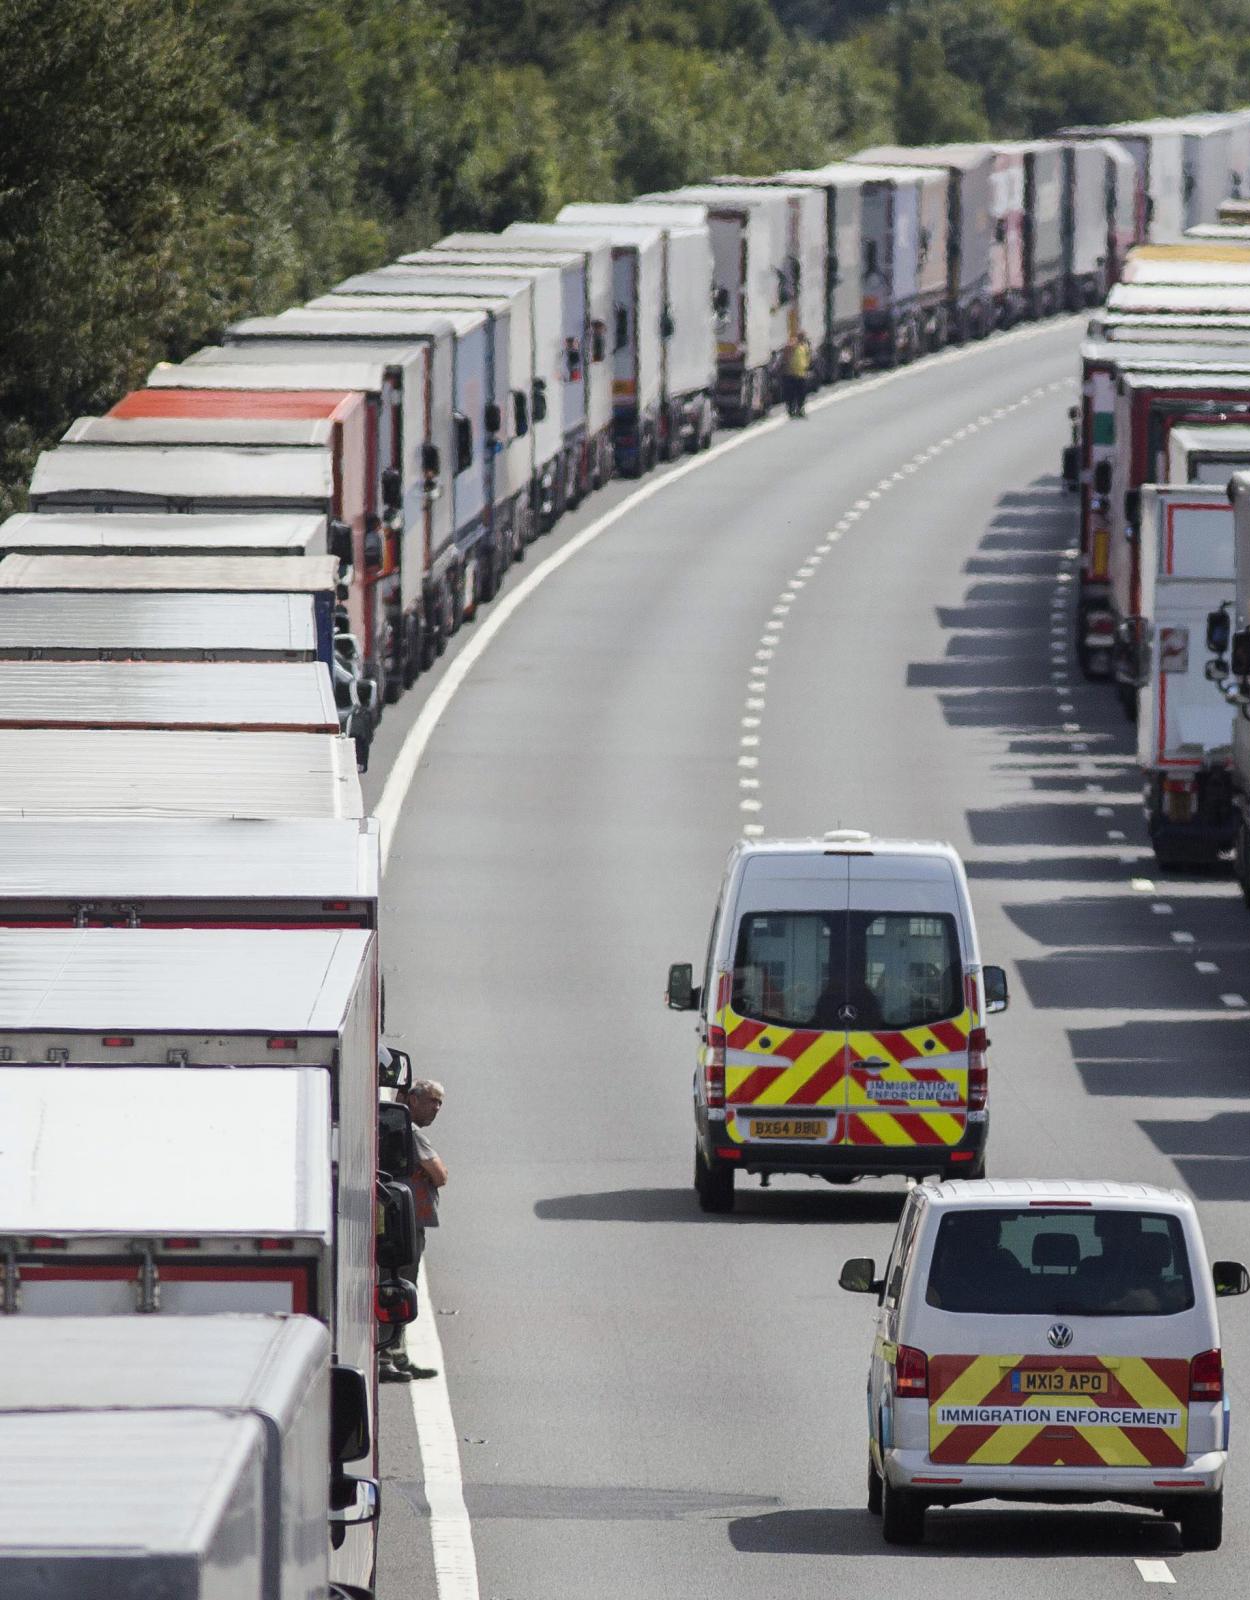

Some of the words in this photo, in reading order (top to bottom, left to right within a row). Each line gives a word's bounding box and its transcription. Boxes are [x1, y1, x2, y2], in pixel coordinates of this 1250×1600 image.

[870, 1080, 956, 1091] IMMIGRATION
[867, 1090, 959, 1101] ENFORCEMENT
[1026, 1375, 1064, 1390] MX13
[1069, 1375, 1102, 1391] APO
[941, 1409, 1051, 1422] IMMIGRATION
[1056, 1411, 1177, 1425] ENFORCEMENT
